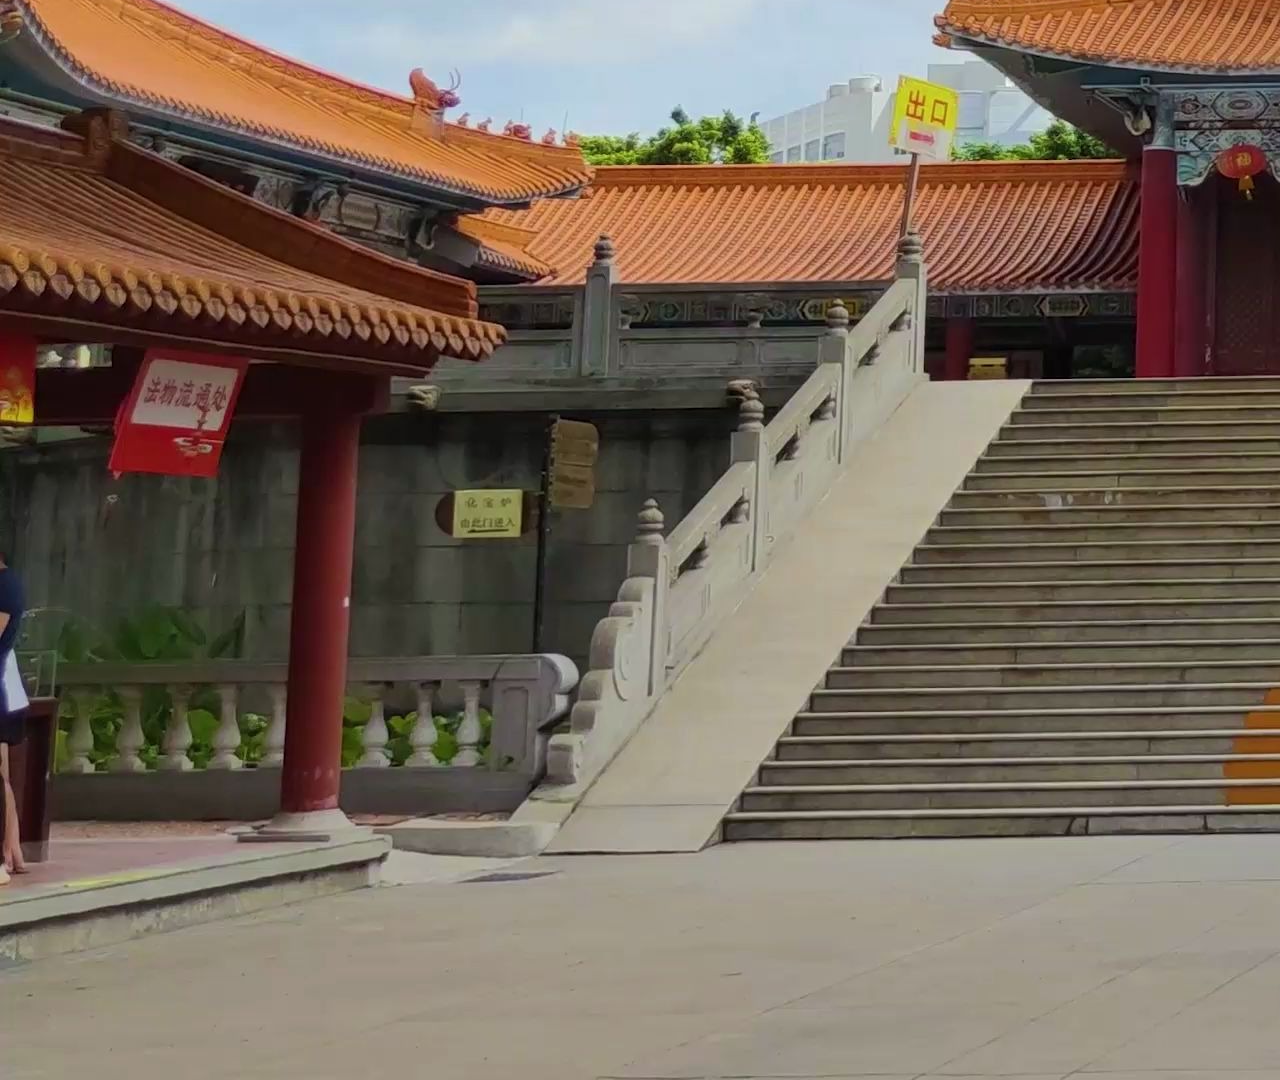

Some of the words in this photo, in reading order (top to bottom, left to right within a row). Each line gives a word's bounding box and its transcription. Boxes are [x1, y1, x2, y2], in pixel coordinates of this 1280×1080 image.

[905, 89, 949, 127] 出口
[143, 376, 228, 412] 法物流通处
[460, 517, 516, 529] 由此门进入
